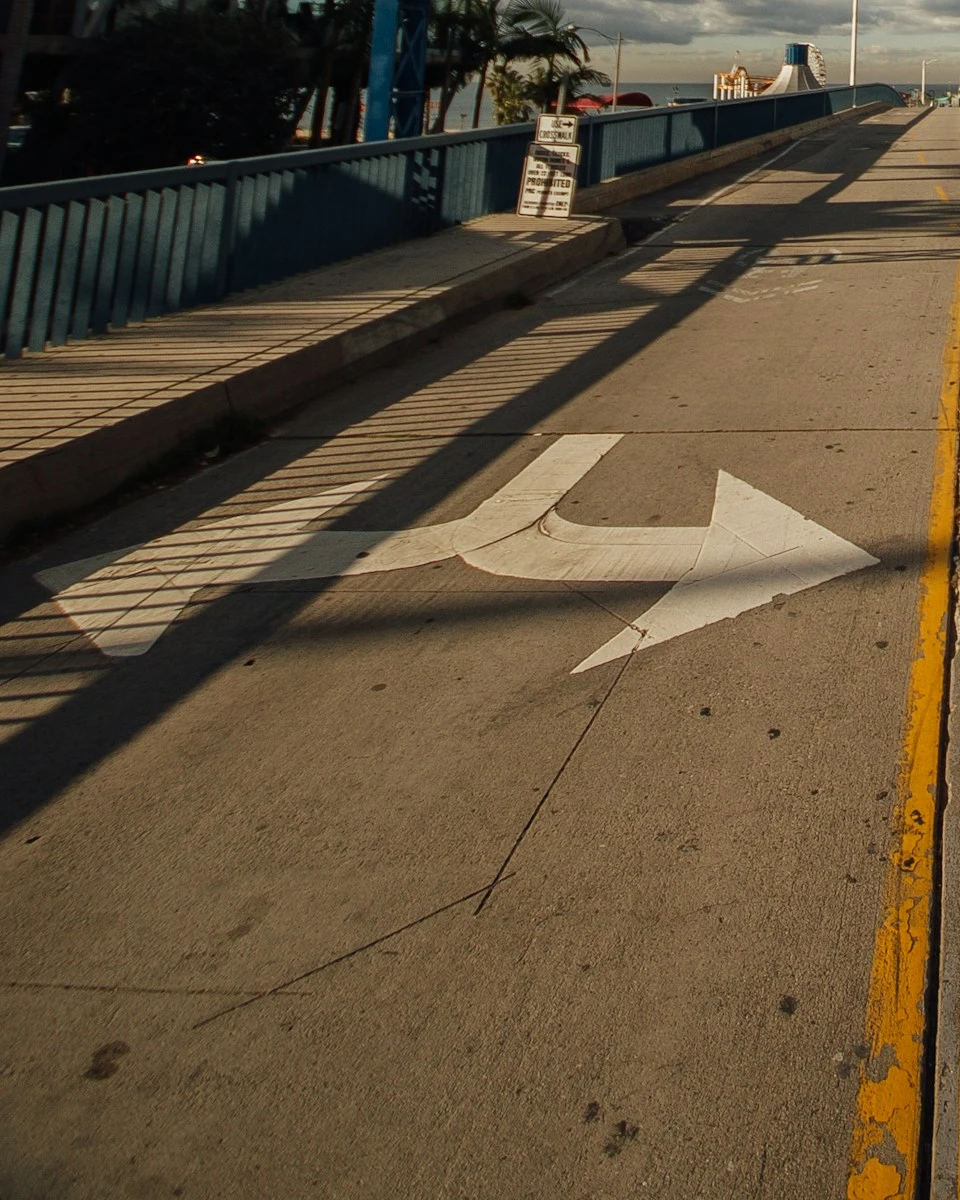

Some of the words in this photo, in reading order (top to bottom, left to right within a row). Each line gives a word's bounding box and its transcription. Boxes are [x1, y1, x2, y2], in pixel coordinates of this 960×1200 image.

[551, 119, 562, 128] USE
[539, 130, 572, 140] CROSSWALK
[526, 178, 571, 188] PROHIBITED
